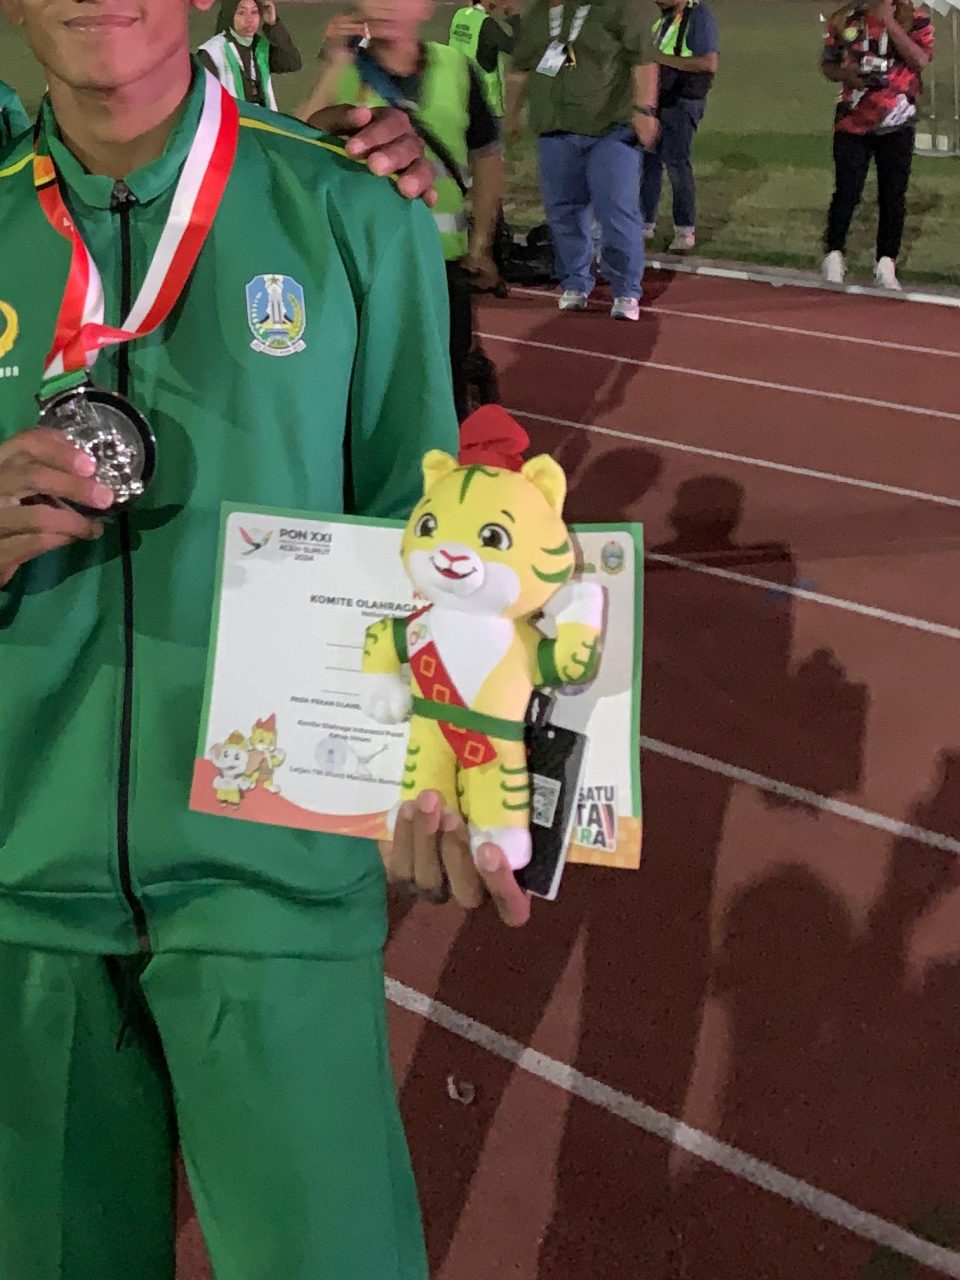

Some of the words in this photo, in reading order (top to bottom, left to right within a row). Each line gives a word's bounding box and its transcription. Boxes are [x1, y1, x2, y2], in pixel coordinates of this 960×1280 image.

[279, 528, 308, 541] PON
[310, 531, 332, 543] XXI
[309, 594, 354, 608] KOMITE
[356, 599, 418, 612] OLAHRAGA
[579, 785, 615, 802] SATU
